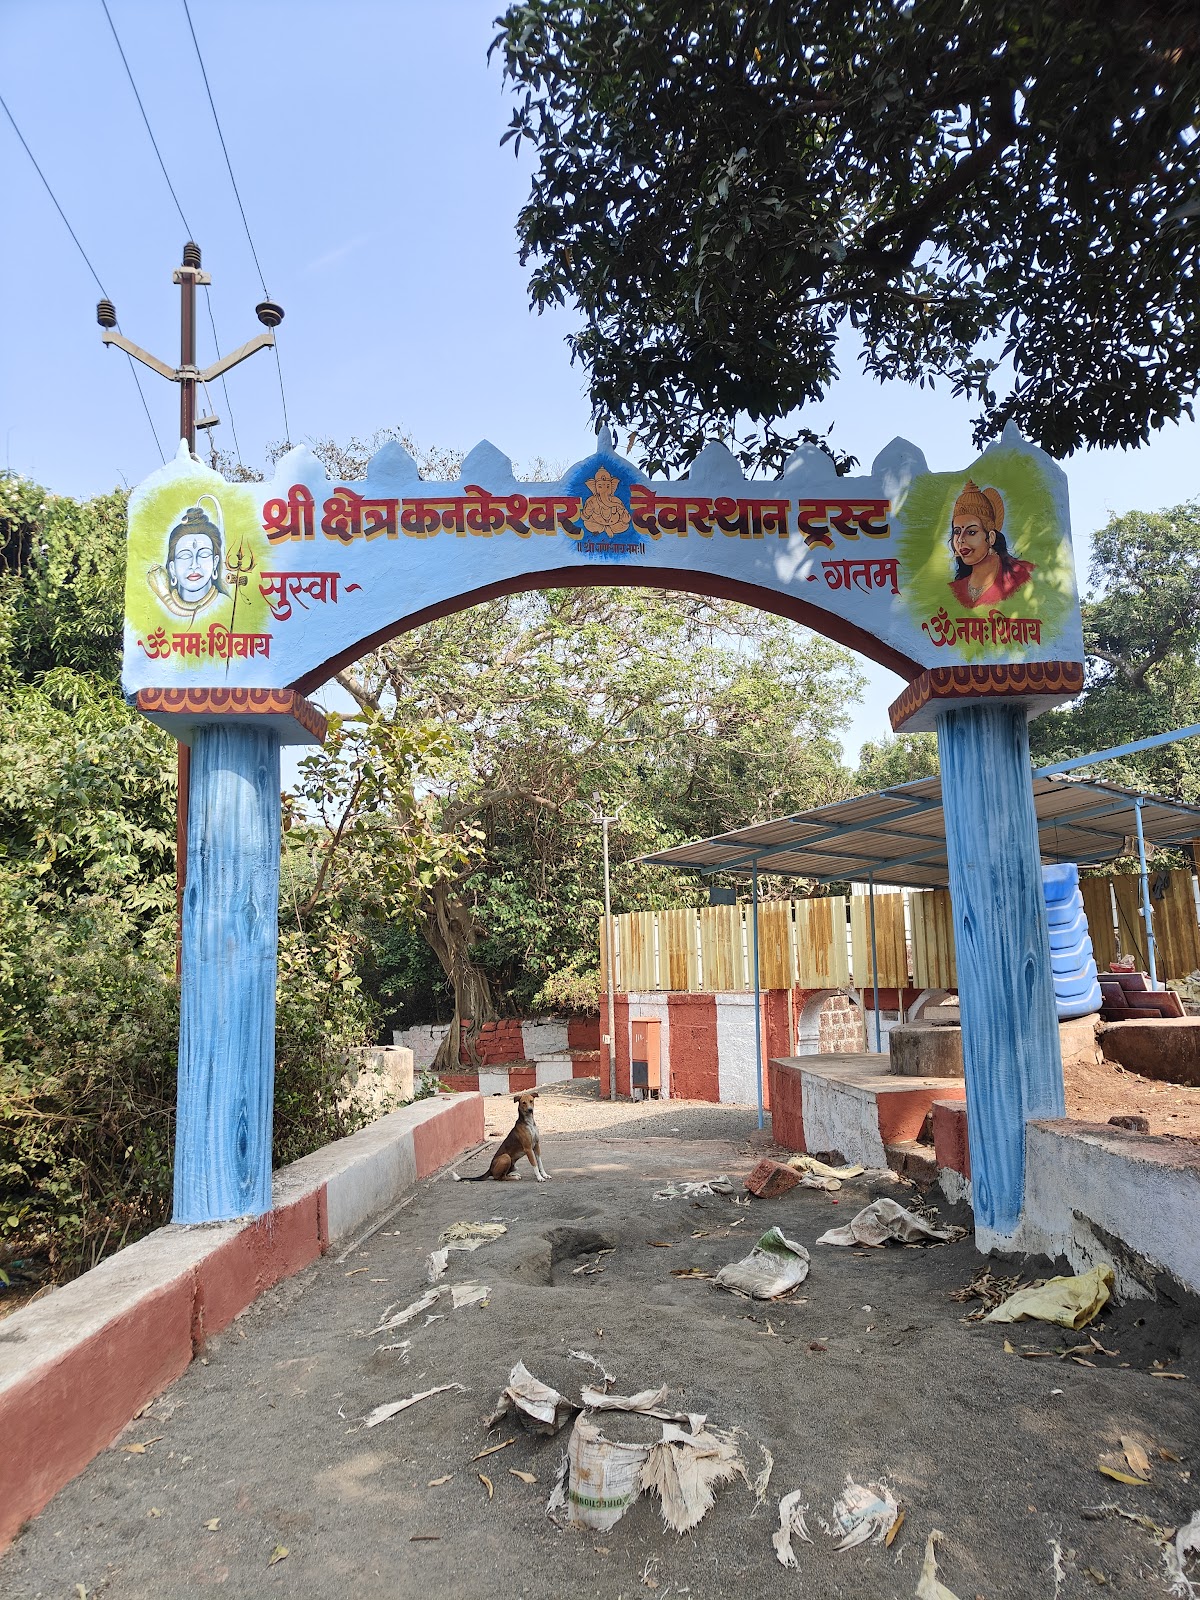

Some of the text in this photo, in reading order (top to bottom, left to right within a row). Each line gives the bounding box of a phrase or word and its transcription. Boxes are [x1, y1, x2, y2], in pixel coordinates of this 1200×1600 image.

[262, 484, 892, 550] श्री क्षेत्र कनकेश्वर देवस्थान ट्रस्ट
[138, 626, 171, 659] ॐ
[921, 606, 957, 647] ॐ
